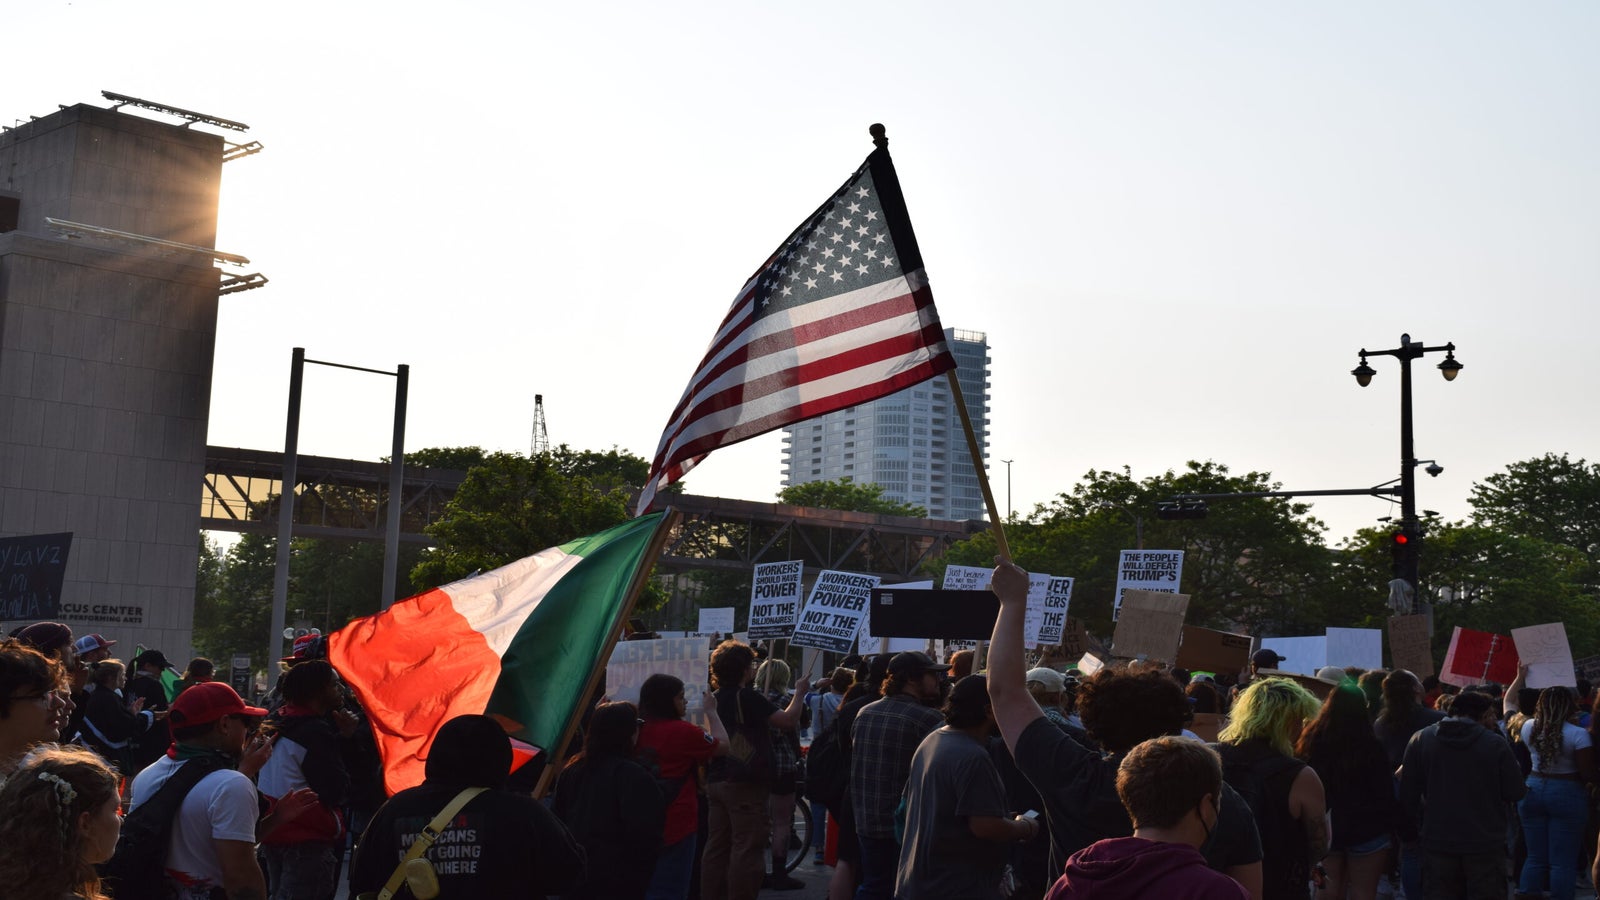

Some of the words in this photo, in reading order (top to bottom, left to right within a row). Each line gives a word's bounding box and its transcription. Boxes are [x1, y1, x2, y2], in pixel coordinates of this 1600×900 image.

[1124, 553, 1141, 561] THE
[1143, 553, 1179, 562] PEOPLE
[757, 563, 799, 576] WORKERS
[1123, 562, 1143, 570] WILL
[1145, 562, 1178, 570] DEFEAT
[756, 576, 780, 585] SHOULD
[782, 574, 798, 583] HAVE
[948, 568, 962, 577] Just
[963, 569, 985, 578] because
[1122, 570, 1177, 581] TRUMP'S
[822, 573, 875, 588] WORKERS
[755, 582, 797, 599] POWER
[817, 583, 848, 594] SHOULD
[848, 588, 871, 598] HAVE
[811, 591, 867, 611] POWER
[92, 604, 143, 616] CENTER
[752, 604, 773, 617] NOT
[776, 603, 795, 615] THE
[69, 614, 121, 622] PERFORMING
[752, 616, 794, 625] BILLIONAIRES!
[803, 611, 831, 625] NOT
[831, 615, 859, 630] THE
[1043, 612, 1065, 626] THE
[799, 624, 853, 638] BILLIONAIRES!
[437, 845, 481, 859] GOING
